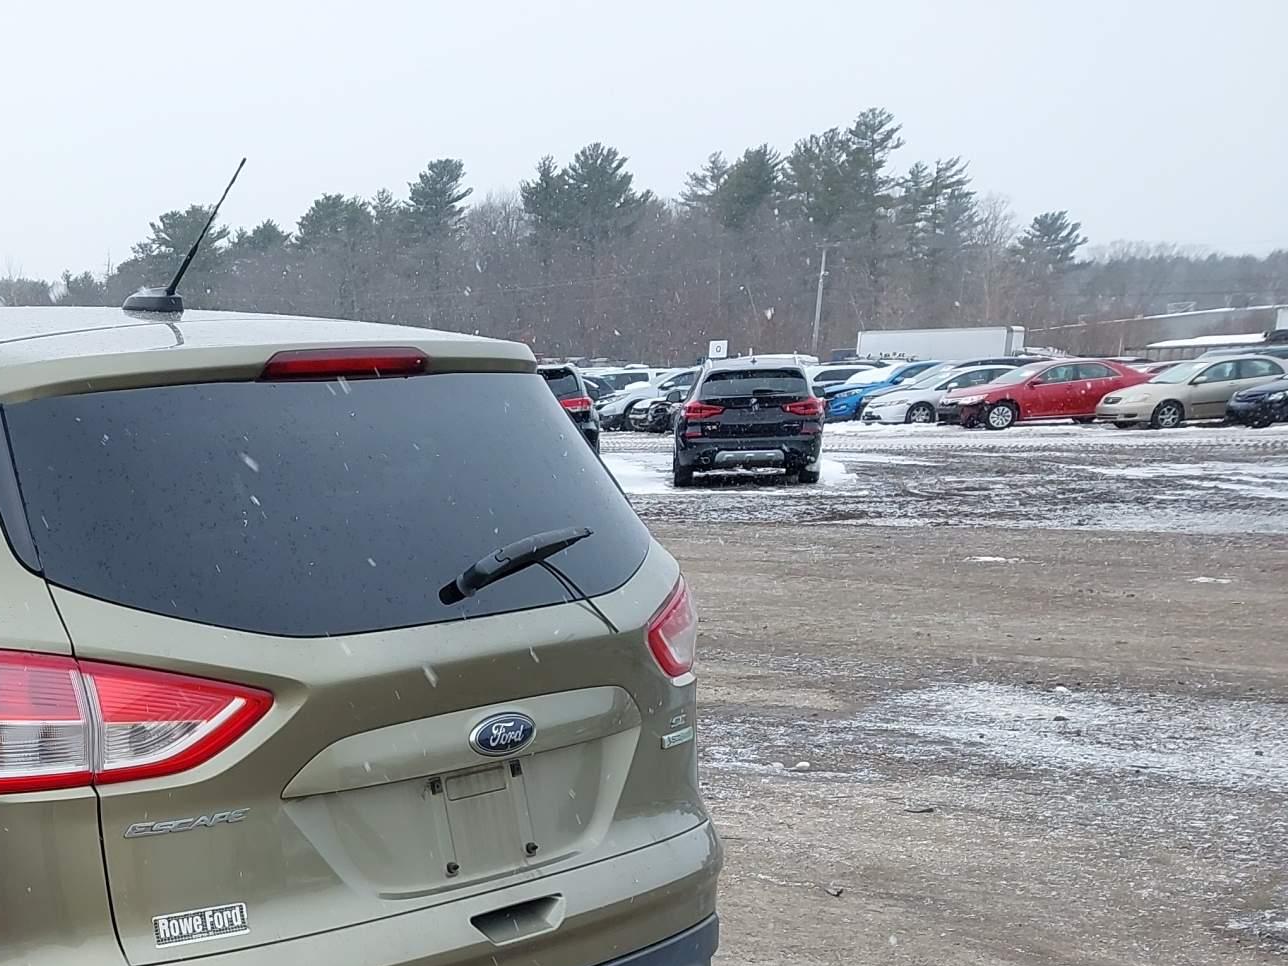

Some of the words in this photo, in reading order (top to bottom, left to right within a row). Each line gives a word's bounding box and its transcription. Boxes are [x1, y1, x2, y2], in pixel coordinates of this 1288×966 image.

[489, 721, 524, 747] Ford
[124, 807, 251, 838] ESCAPE
[158, 918, 203, 939] Rowe
[204, 906, 244, 931] Ford
